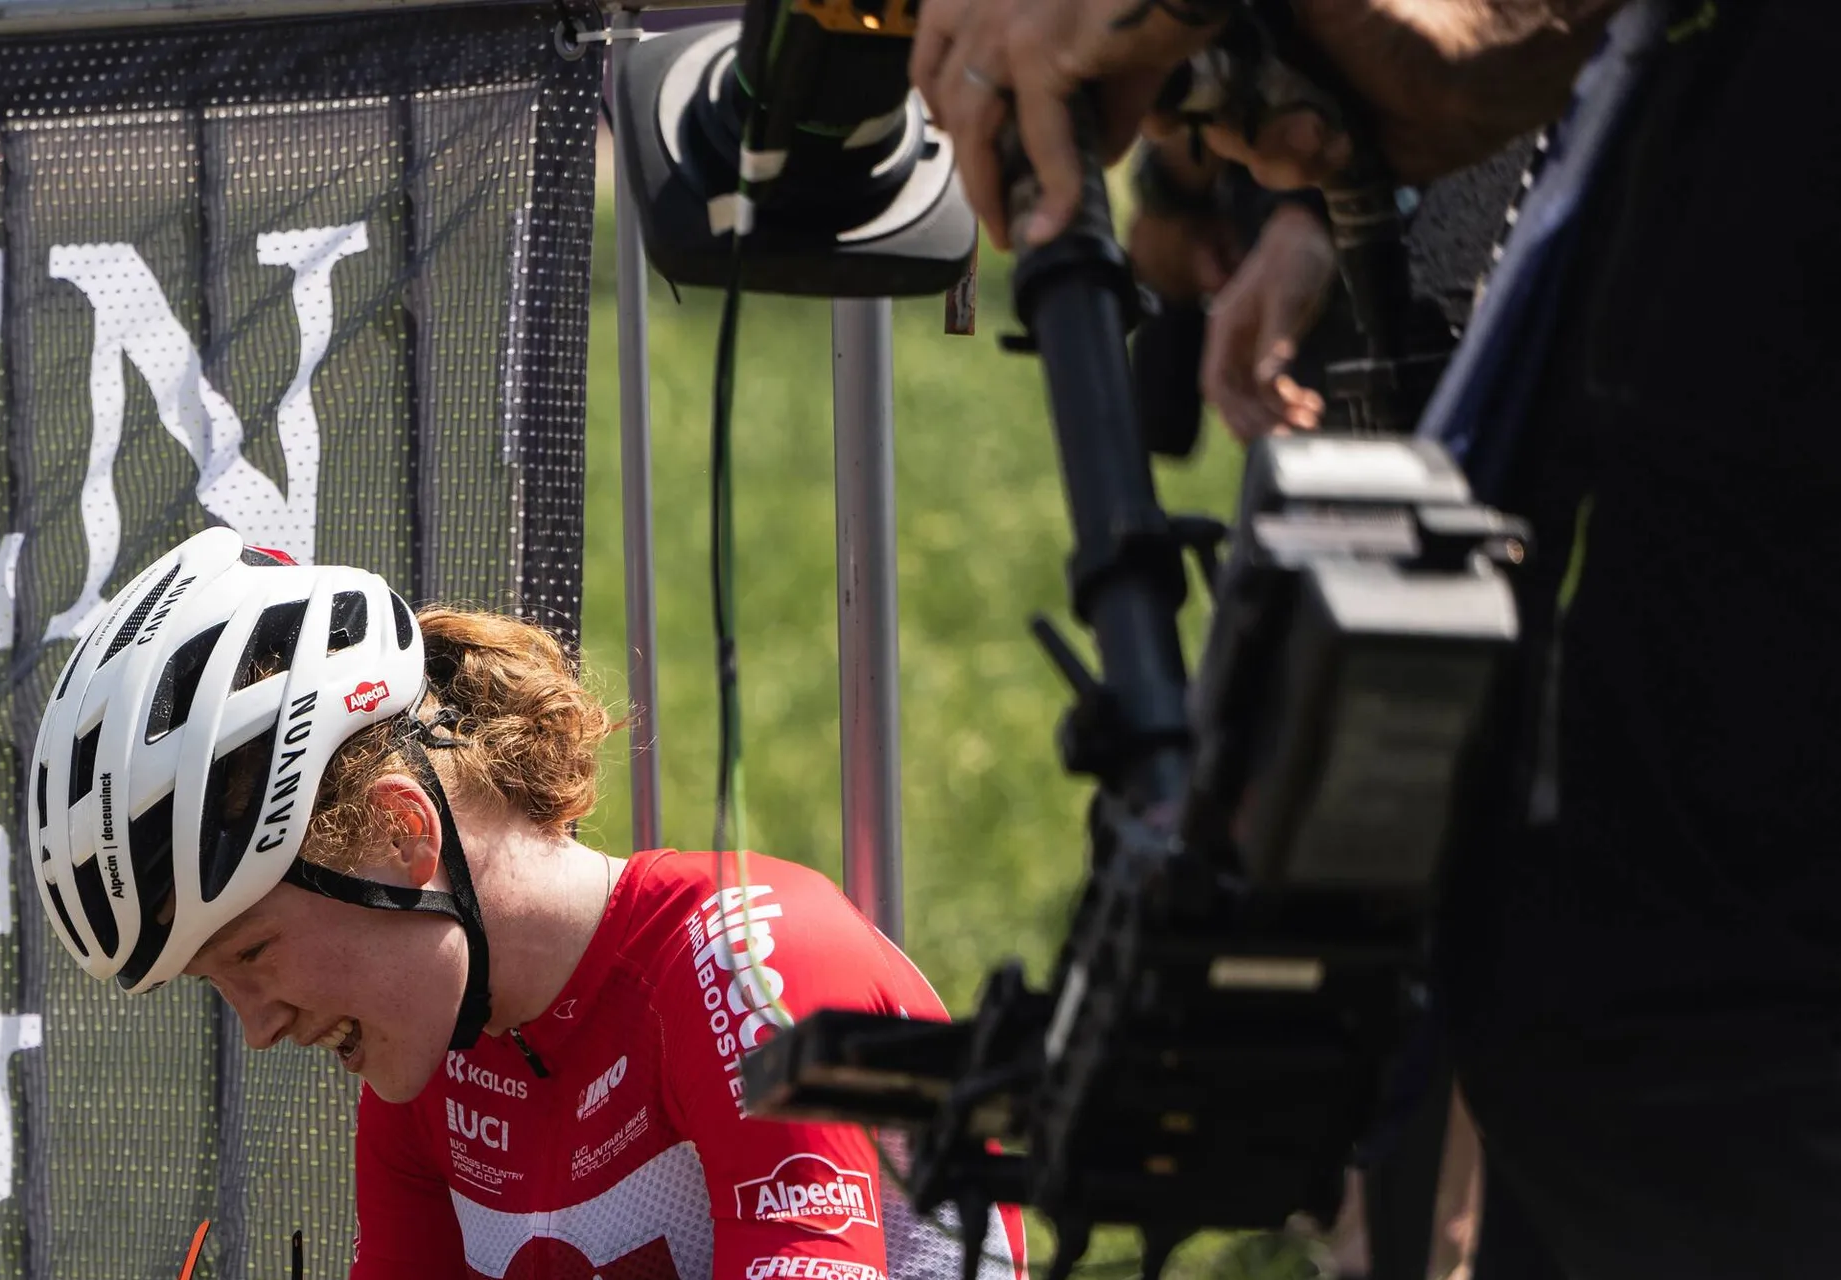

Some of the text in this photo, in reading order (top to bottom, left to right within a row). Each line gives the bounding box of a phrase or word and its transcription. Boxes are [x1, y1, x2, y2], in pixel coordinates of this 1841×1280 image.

[137, 575, 197, 645] CANYON
[349, 685, 387, 710] Alpecin
[255, 690, 319, 853] CANYON
[99, 772, 114, 841] deceuninck
[104, 855, 125, 899] Alpecin
[685, 911, 705, 951] HAIR
[693, 884, 795, 1052] Alpec
[456, 1102, 509, 1152] UCI
[571, 1105, 647, 1171] MOUNTAIN BIKE
[451, 1150, 525, 1181] CROSS COUNTRY
[571, 1118, 649, 1181] WORLD SERIES
[453, 1159, 503, 1185] WORLD CUP
[755, 1175, 865, 1217] Alpecin
[800, 1206, 868, 1219] BOOSTER
[831, 1263, 861, 1273] IVECO
